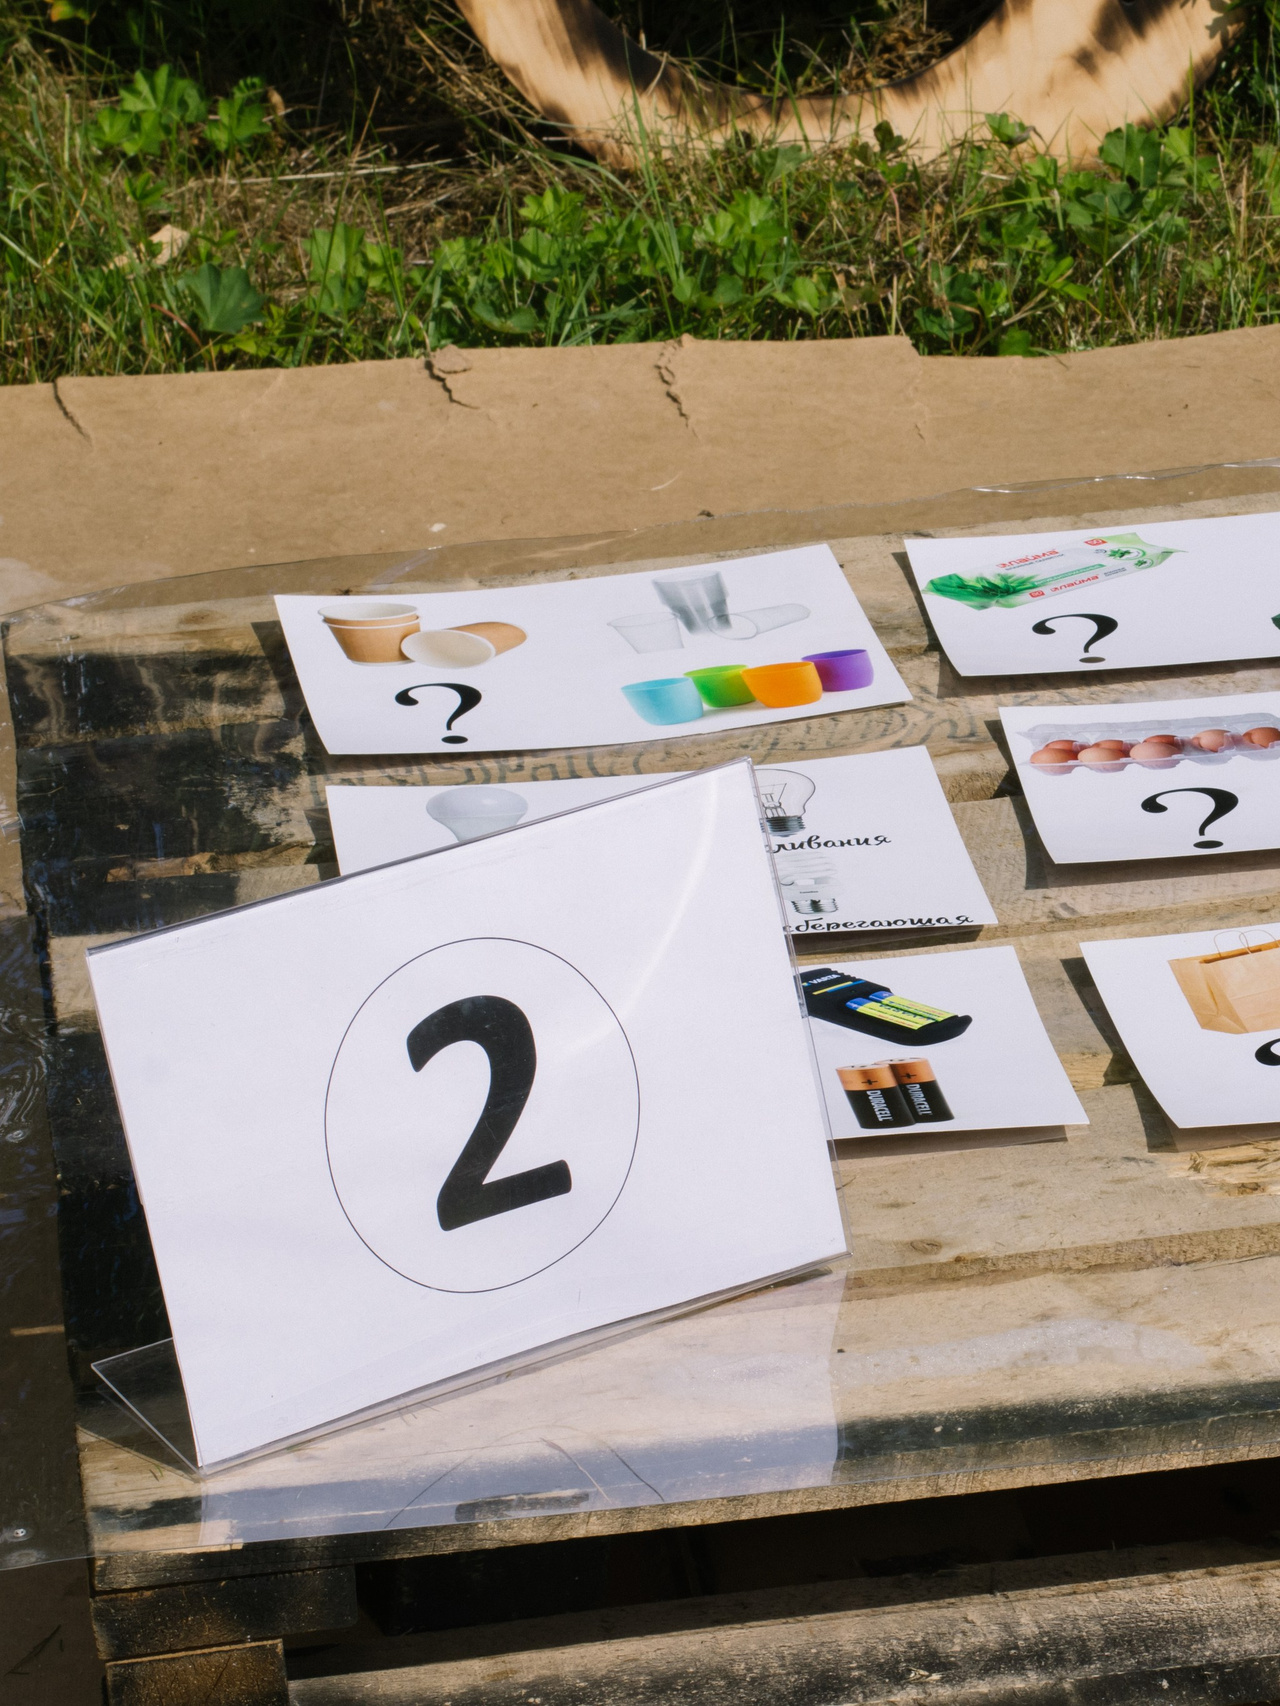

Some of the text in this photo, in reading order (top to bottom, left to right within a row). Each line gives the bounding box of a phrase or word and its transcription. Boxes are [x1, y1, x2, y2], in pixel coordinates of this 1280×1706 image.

[766, 835, 892, 854] ливания
[809, 974, 841, 985] VARTA
[408, 996, 571, 1231] 2
[866, 1090, 893, 1121] DURACELL
[905, 1083, 933, 1116] DURACELL
